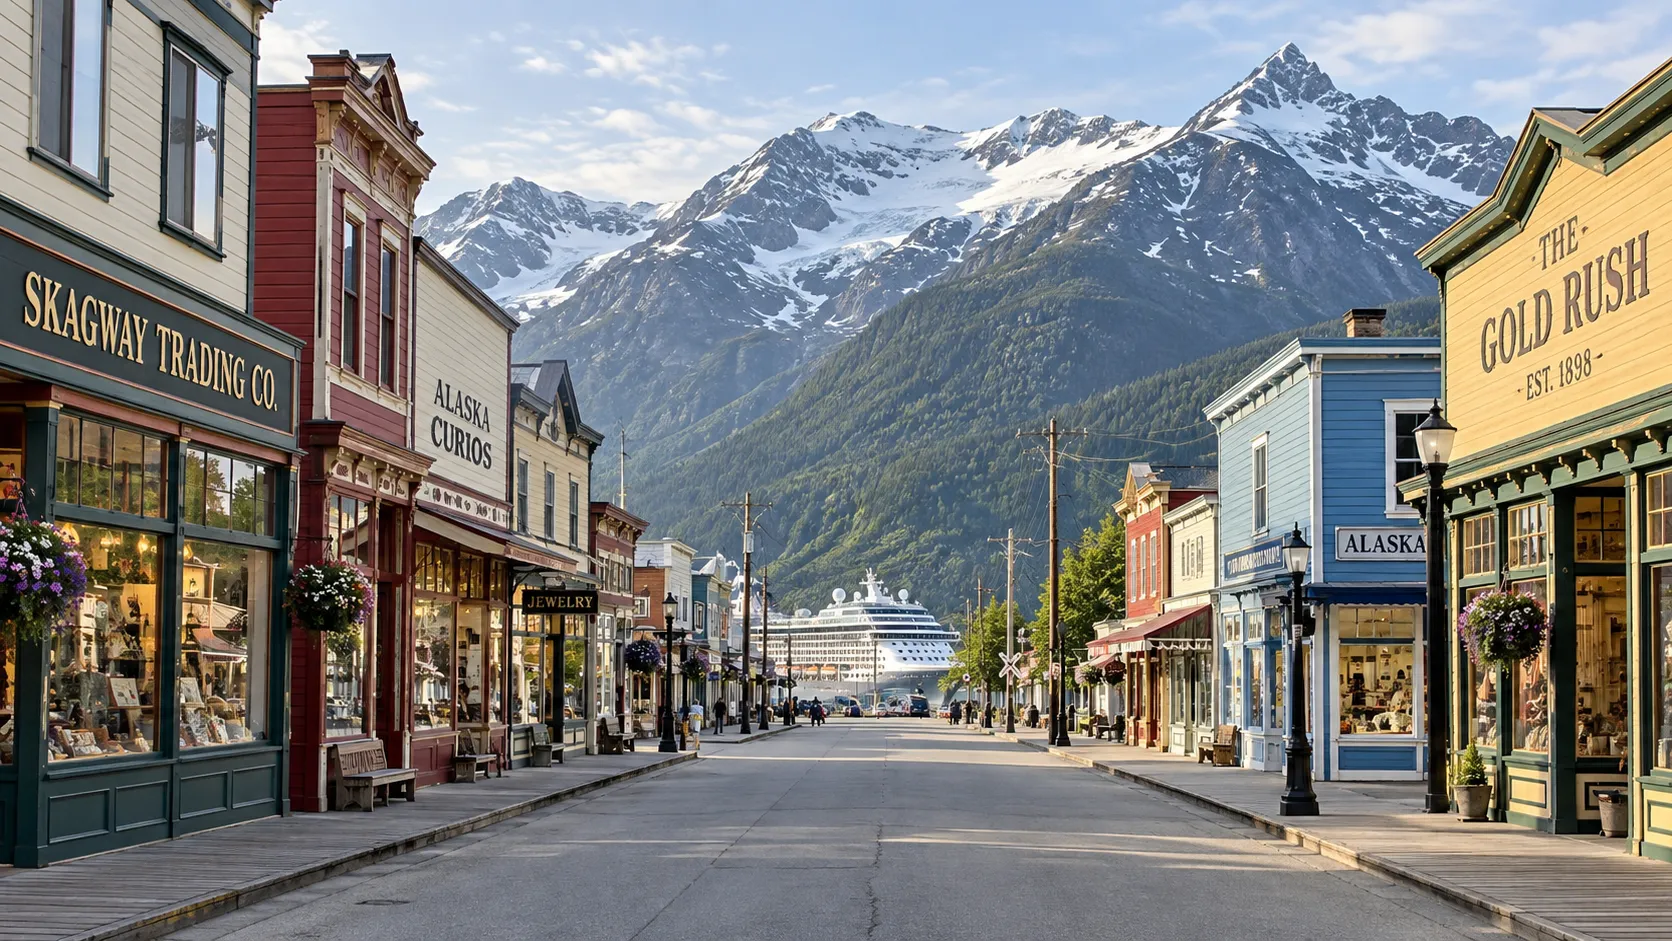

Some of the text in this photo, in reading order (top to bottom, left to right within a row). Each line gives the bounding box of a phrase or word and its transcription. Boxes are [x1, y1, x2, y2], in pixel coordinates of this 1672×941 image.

[1539, 215, 1578, 270] THE
[1481, 230, 1650, 374] GOLD RUSH
[24, 271, 278, 412] SKAGWAY TRADING CO.
[1526, 348, 1592, 401] EST. 1898
[434, 378, 491, 433] ALASKA
[431, 415, 492, 470] CURIOS
[1344, 533, 1426, 553] ALASKA
[527, 595, 593, 609] JEWELRY
